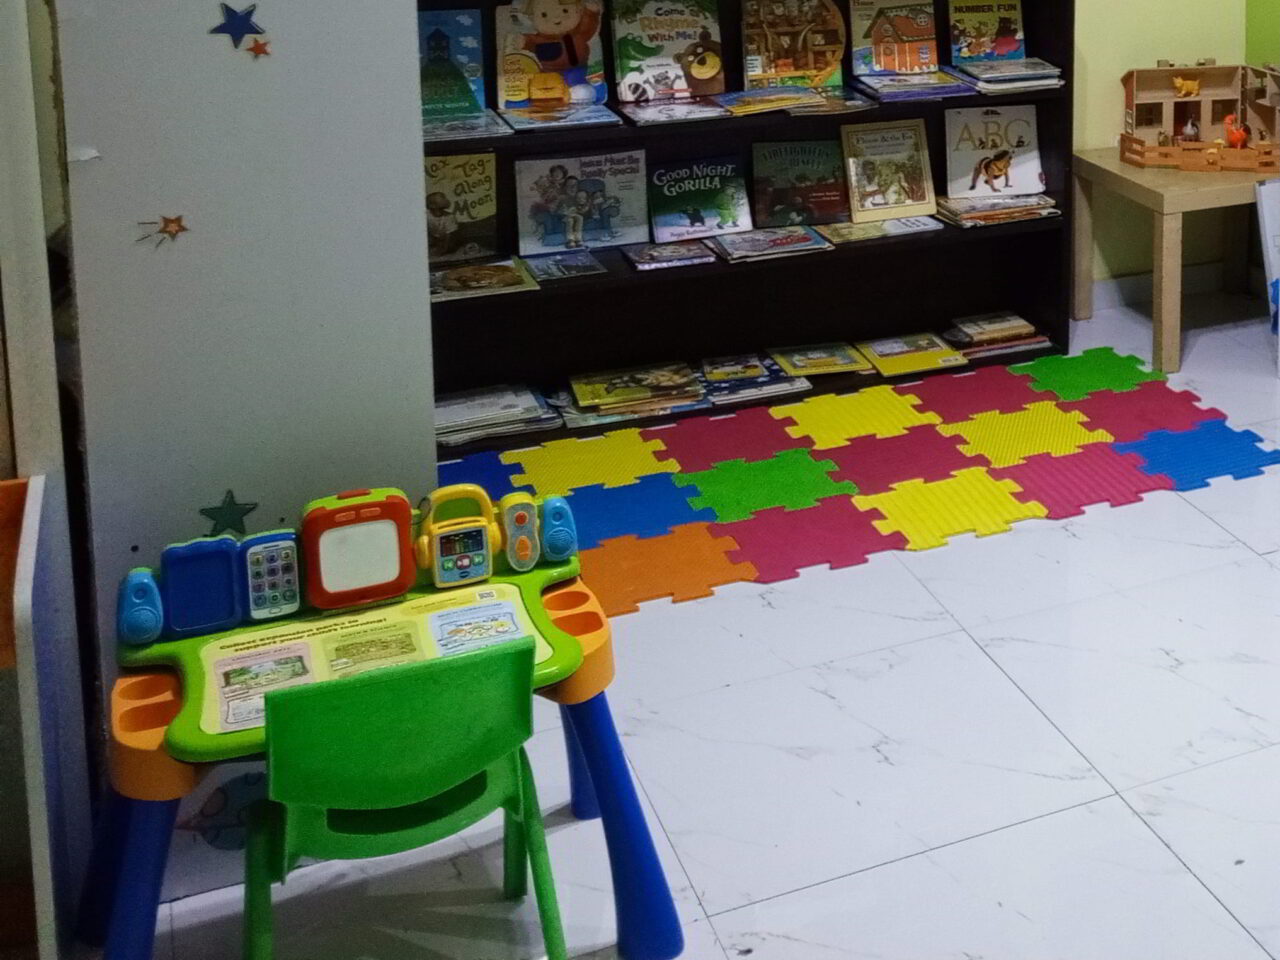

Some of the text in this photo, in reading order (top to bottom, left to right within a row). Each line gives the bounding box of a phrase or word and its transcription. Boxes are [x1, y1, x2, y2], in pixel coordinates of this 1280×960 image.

[654, 7, 686, 17] Come
[953, 3, 1018, 14] NUMBER FUN
[952, 118, 1033, 153] ABC
[653, 169, 690, 186] GOOD
[663, 176, 721, 196] GORILLA
